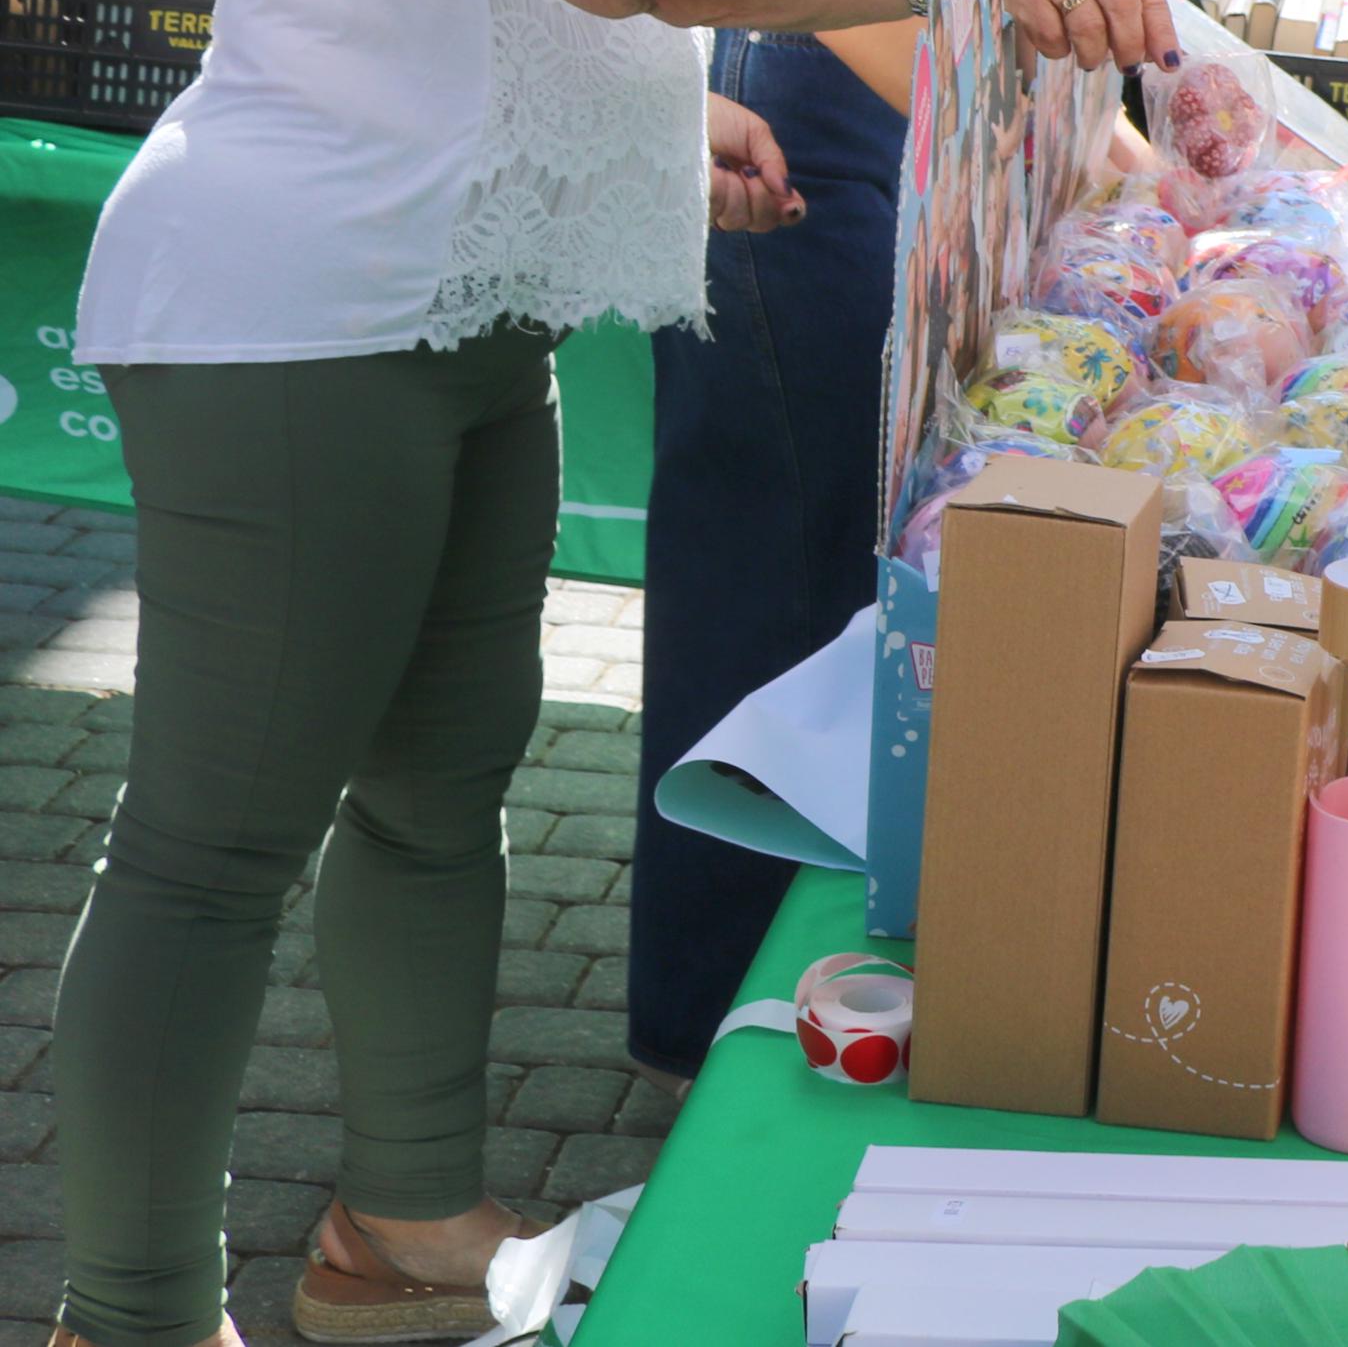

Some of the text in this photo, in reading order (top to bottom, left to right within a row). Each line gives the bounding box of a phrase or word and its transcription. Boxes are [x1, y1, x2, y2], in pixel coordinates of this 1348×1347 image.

[36, 324, 77, 350] a
[49, 366, 108, 395] es
[59, 409, 119, 442] co
